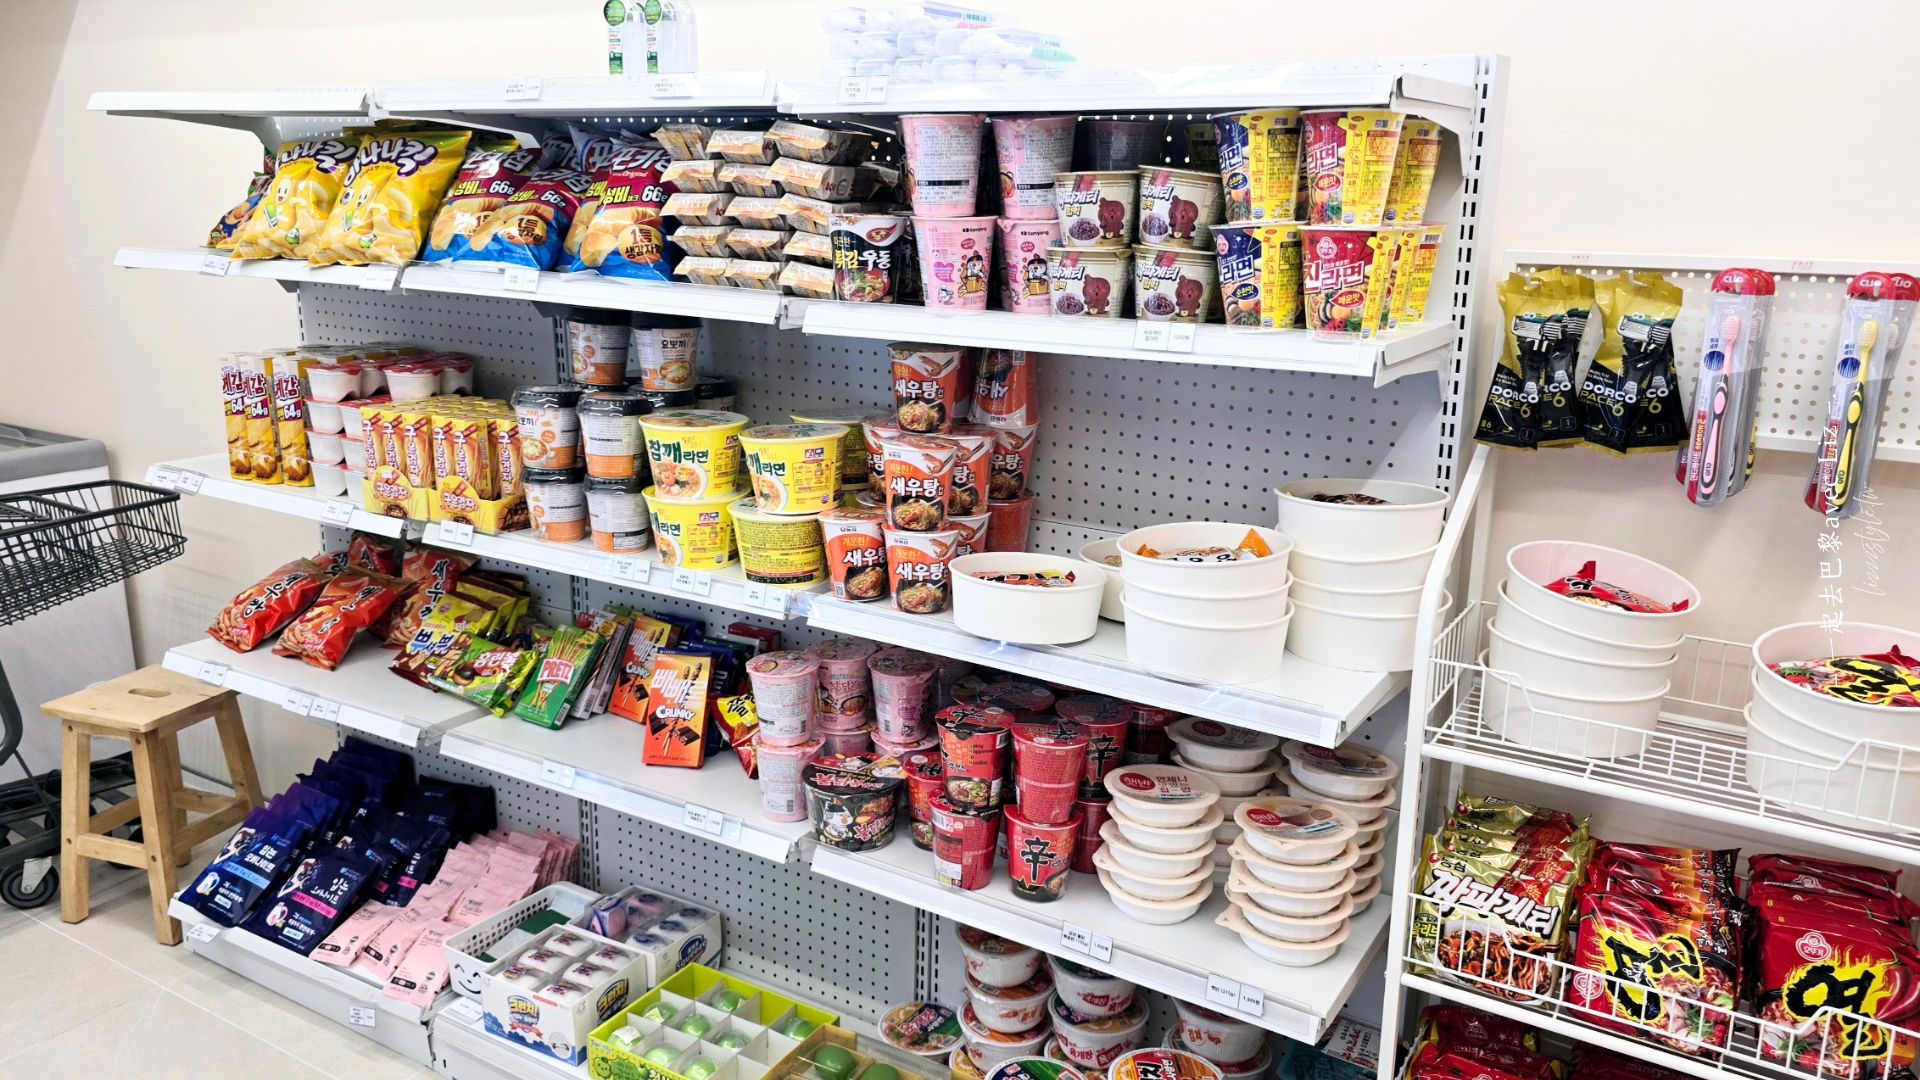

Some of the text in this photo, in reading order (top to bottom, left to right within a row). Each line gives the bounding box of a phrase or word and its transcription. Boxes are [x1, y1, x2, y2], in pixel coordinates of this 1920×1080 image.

[277, 140, 358, 174] 나나킥
[1303, 261, 1364, 293] 진라면
[894, 380, 939, 398] 새우탕
[1491, 385, 1539, 404] DORCO
[1583, 381, 1637, 404] DORCO
[890, 477, 940, 498] 새우탕
[896, 561, 945, 581] 새우탕
[656, 705, 696, 720] CRUNKY
[1020, 836, 1057, 883] 辛
[1424, 868, 1561, 939] 짜파게티
